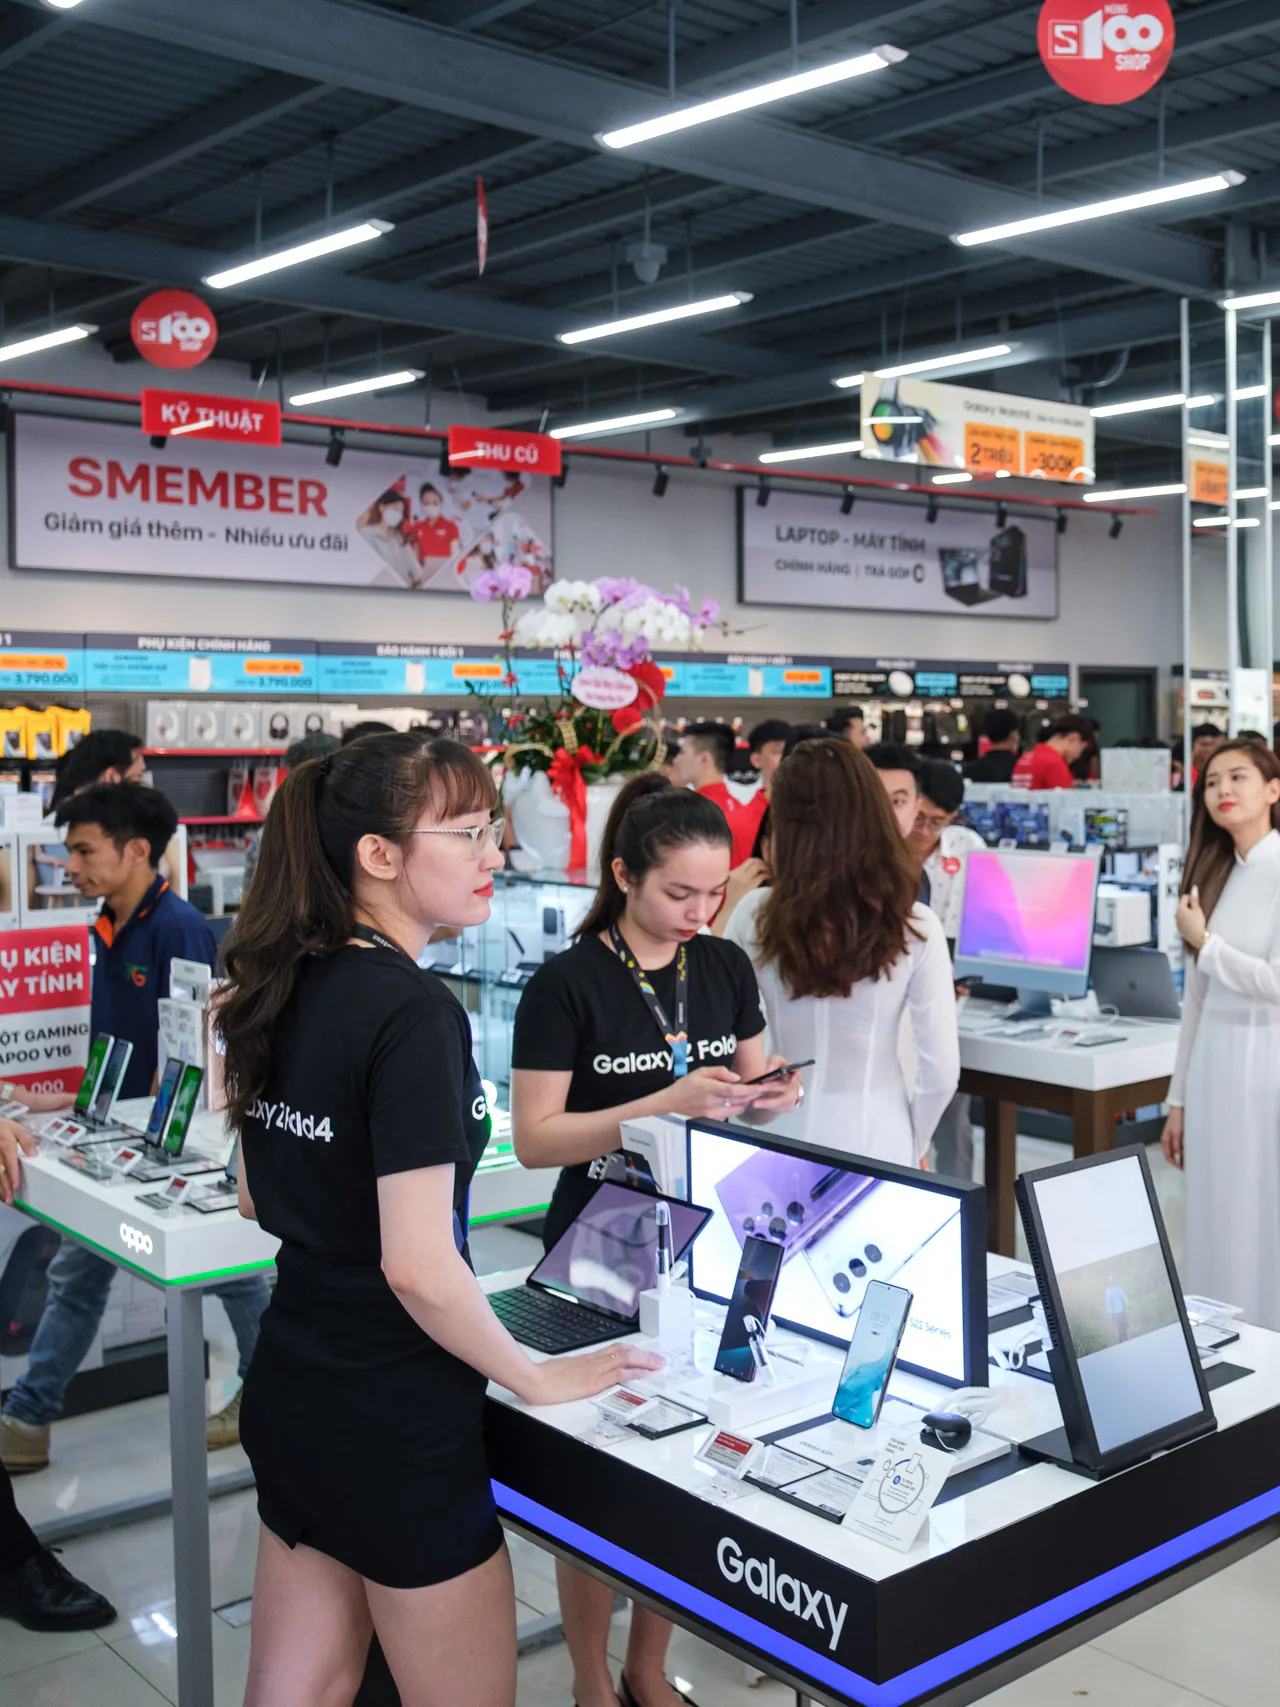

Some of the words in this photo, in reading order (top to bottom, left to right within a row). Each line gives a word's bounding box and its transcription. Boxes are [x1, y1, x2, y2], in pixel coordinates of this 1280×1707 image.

[1115, 53, 1151, 71] SHOP
[196, 405, 264, 435] THUẬT
[475, 441, 511, 461] THU
[970, 441, 981, 465] 2
[68, 455, 328, 518] SMEMBER
[45, 511, 103, 535] Giảm
[108, 517, 142, 541] giá
[147, 520, 203, 542] thêm
[225, 525, 284, 548] Nhiều
[289, 529, 315, 550] ưu
[320, 532, 349, 552] đãi
[775, 524, 840, 546] LAPTOP
[853, 527, 886, 550] MÁY
[891, 531, 926, 554] TÍNH
[24, 940, 82, 968] KIỆN
[24, 970, 83, 996] TÍNH
[25, 1023, 89, 1043] GAMING
[44, 1044, 72, 1060] V16
[593, 1049, 674, 1075] Galaxy
[120, 1222, 154, 1255] oppo
[716, 1536, 849, 1652] Galaxy
